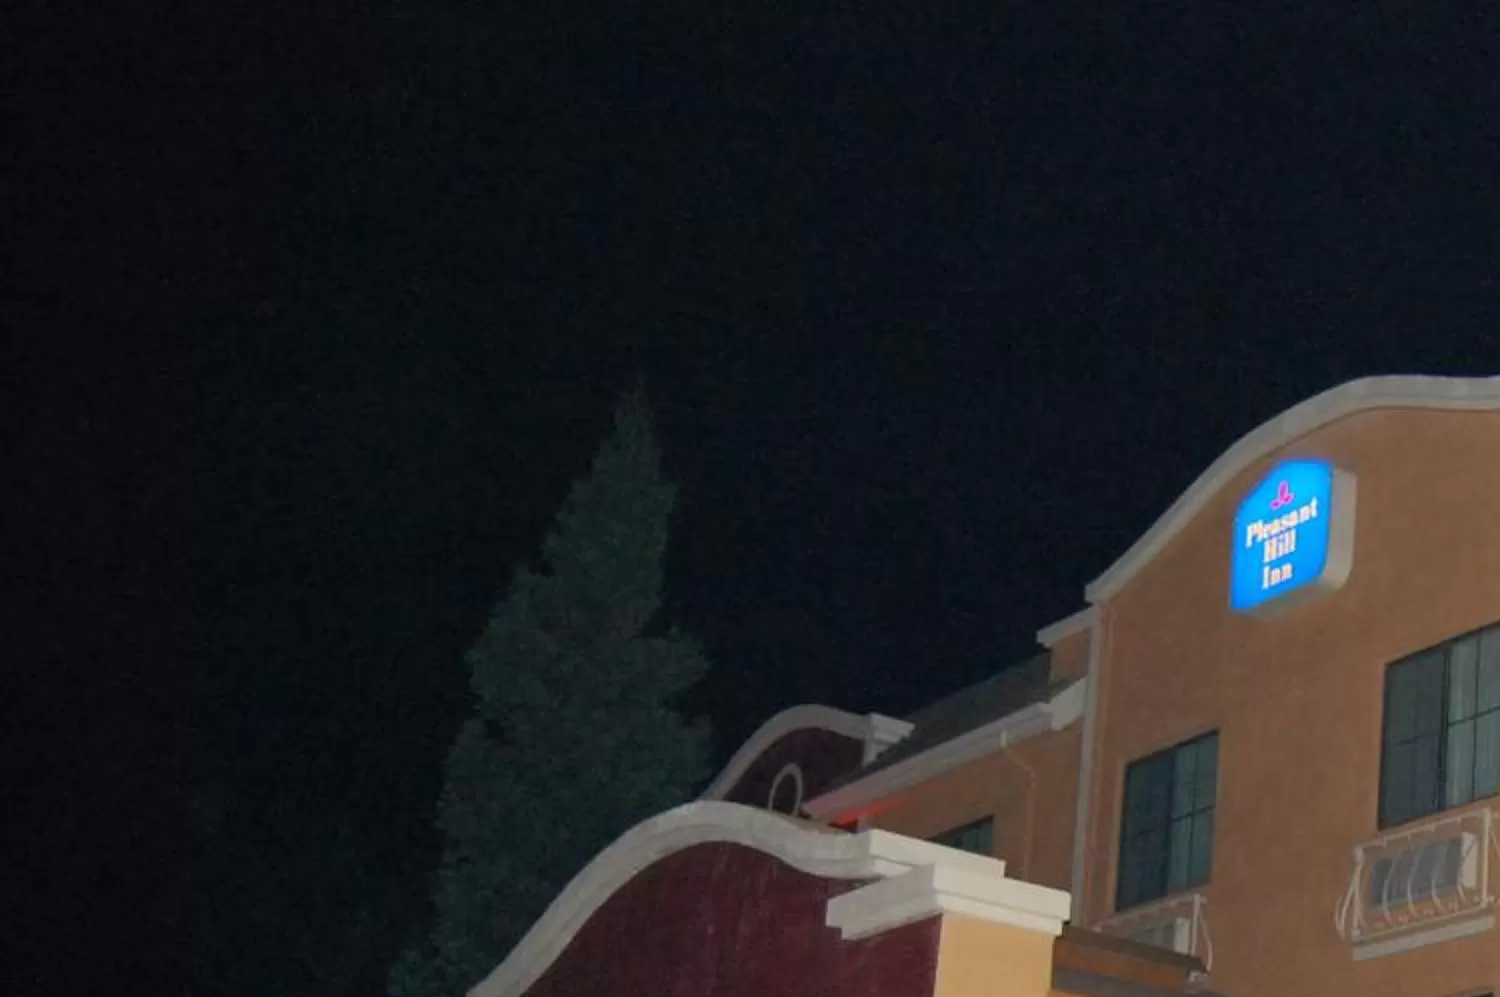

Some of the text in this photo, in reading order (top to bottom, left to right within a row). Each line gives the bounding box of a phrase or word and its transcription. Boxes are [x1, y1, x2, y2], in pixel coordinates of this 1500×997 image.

[1246, 496, 1318, 548] Pleasant
[1263, 528, 1296, 563] Hill
[1262, 563, 1293, 589] Inn
